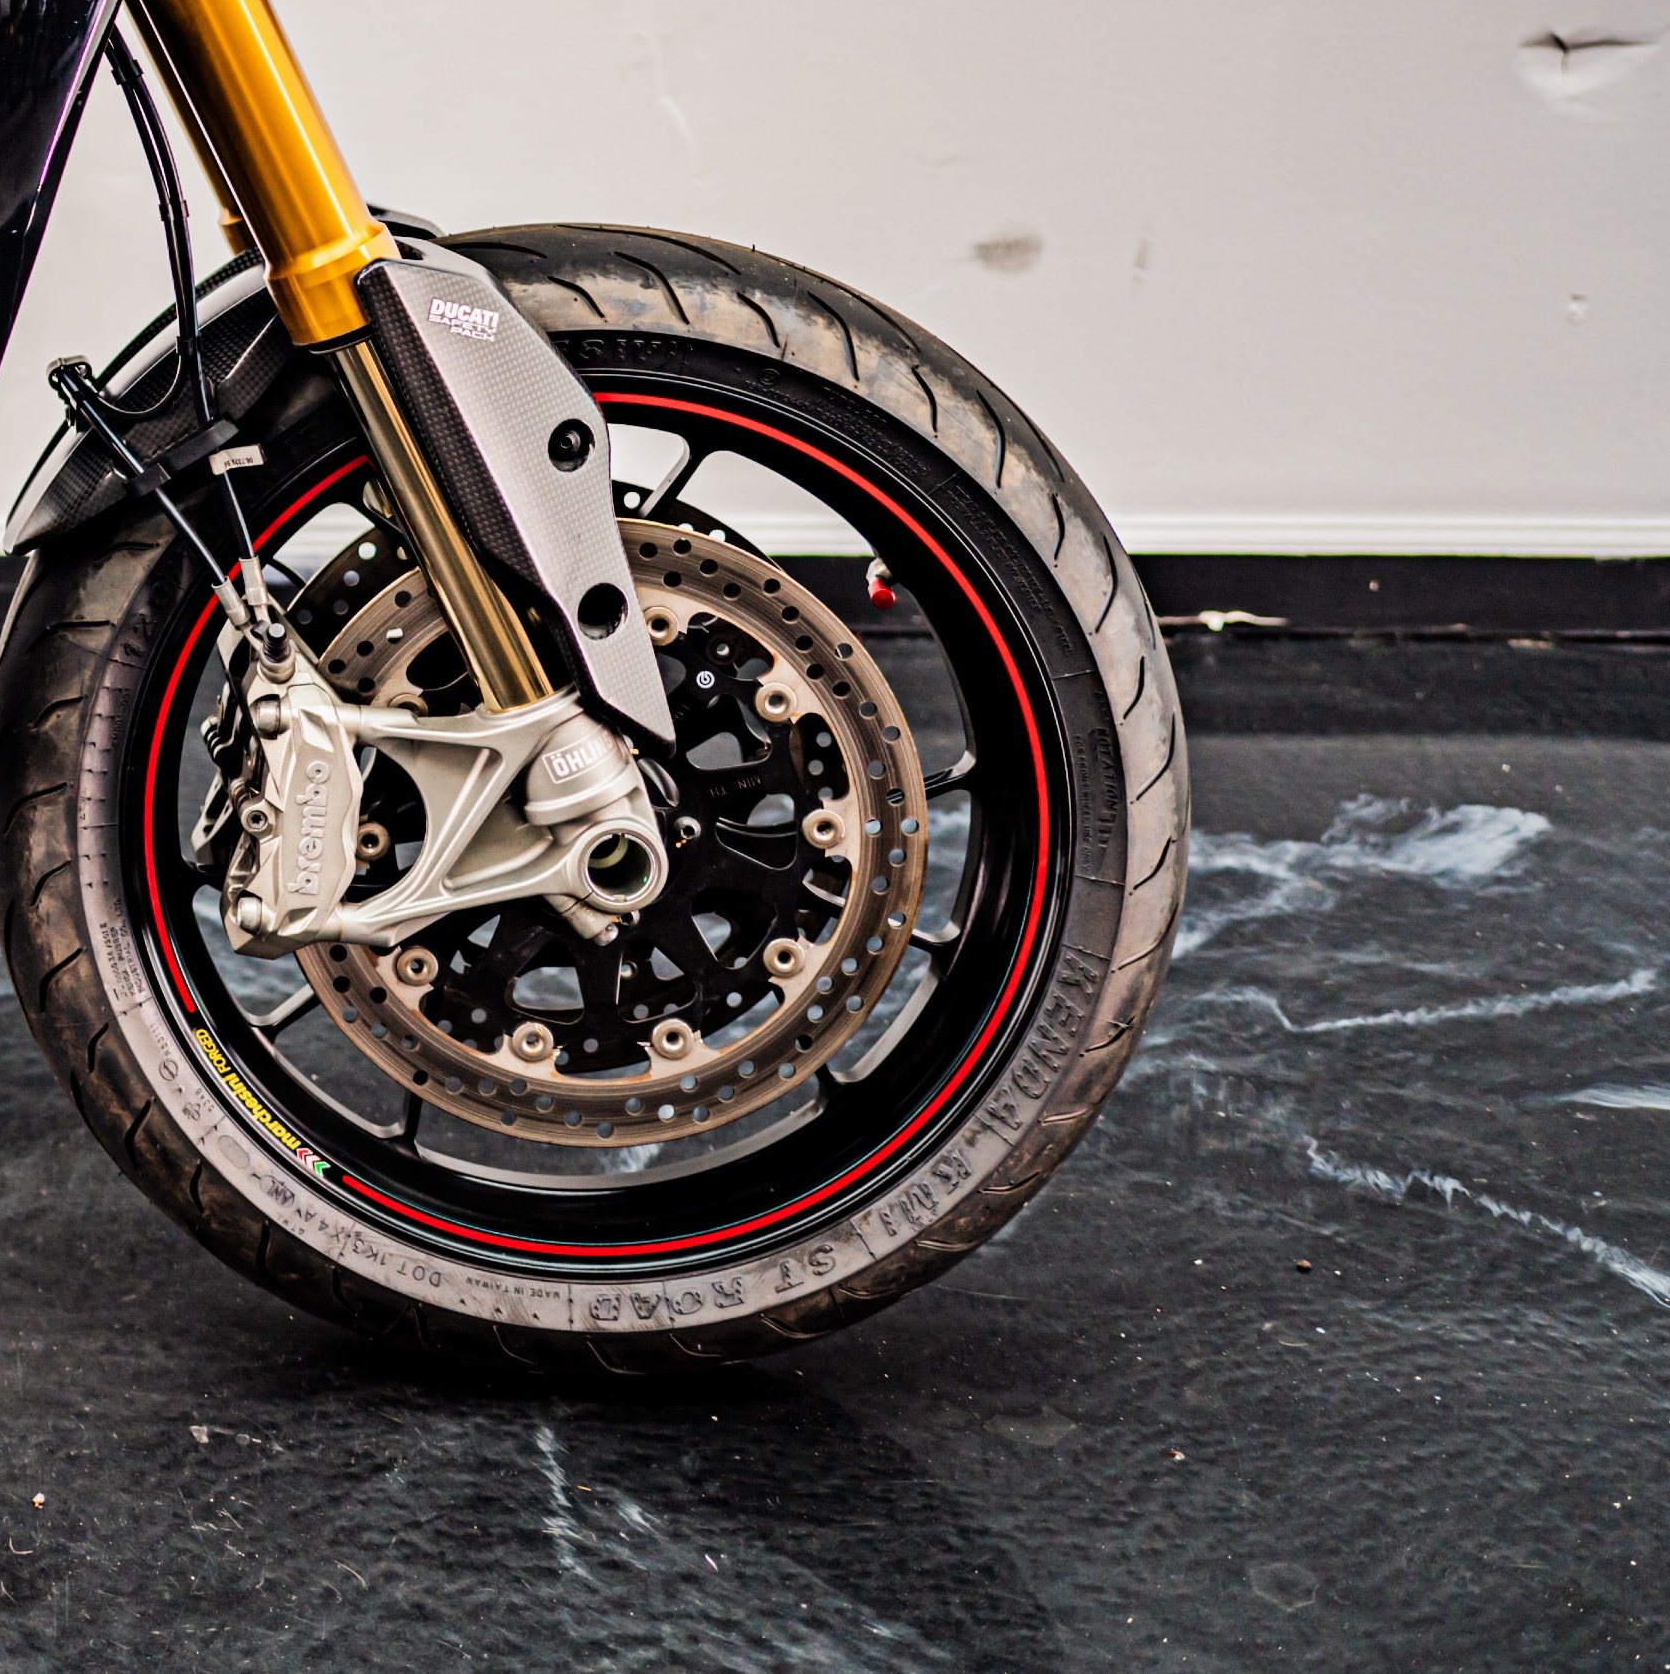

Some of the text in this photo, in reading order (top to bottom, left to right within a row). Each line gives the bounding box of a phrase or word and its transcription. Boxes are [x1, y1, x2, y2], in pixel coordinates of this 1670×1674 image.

[428, 314, 497, 333] SAFETY
[430, 298, 499, 328] DUCATI
[450, 328, 496, 342] PACK
[1095, 726, 1117, 813] ROTATION
[287, 761, 330, 895] brembo
[981, 950, 1106, 1137] KENDA
[191, 1022, 303, 1155] marchesini FORGED
[392, 1257, 444, 1288] DOT
[462, 1274, 561, 1300] MADE IN TAIWAN
[765, 1239, 842, 1295] ST
[587, 1270, 751, 1326] ROAD
